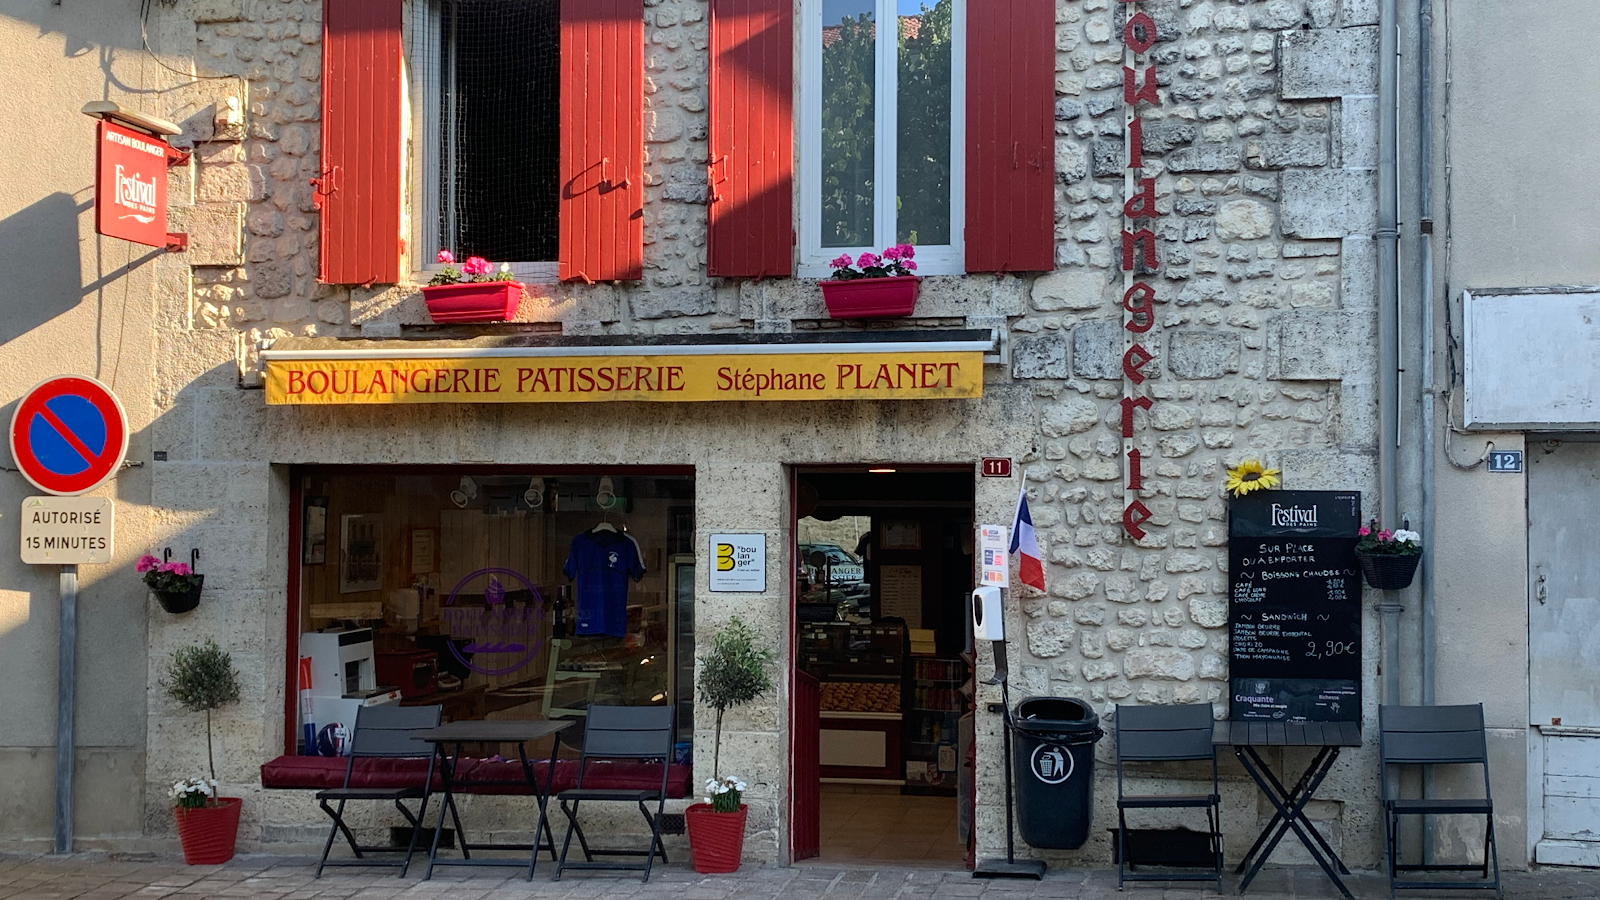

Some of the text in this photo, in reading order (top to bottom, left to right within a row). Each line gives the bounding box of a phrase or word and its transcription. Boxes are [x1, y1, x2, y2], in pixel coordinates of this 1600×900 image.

[106, 130, 164, 158] ARTISAN BOULANGER
[115, 164, 156, 207] Festival
[1118, 0, 1160, 541] oulangerie
[286, 362, 960, 396] BOULANGERIE PATISSERIE Stéphane PLANET
[989, 461, 1002, 474] 11
[1494, 454, 1515, 469] 12
[32, 509, 101, 524] AUTORISÉ
[1271, 503, 1318, 526] Festival
[25, 537, 106, 549] 15 MINUTES
[1259, 542, 1315, 554] SUR PLACE
[1242, 557, 1256, 566] OU
[1268, 555, 1316, 565] EMPORTER
[1305, 640, 1356, 660] 2,90€
[1235, 694, 1274, 704] Craquante
